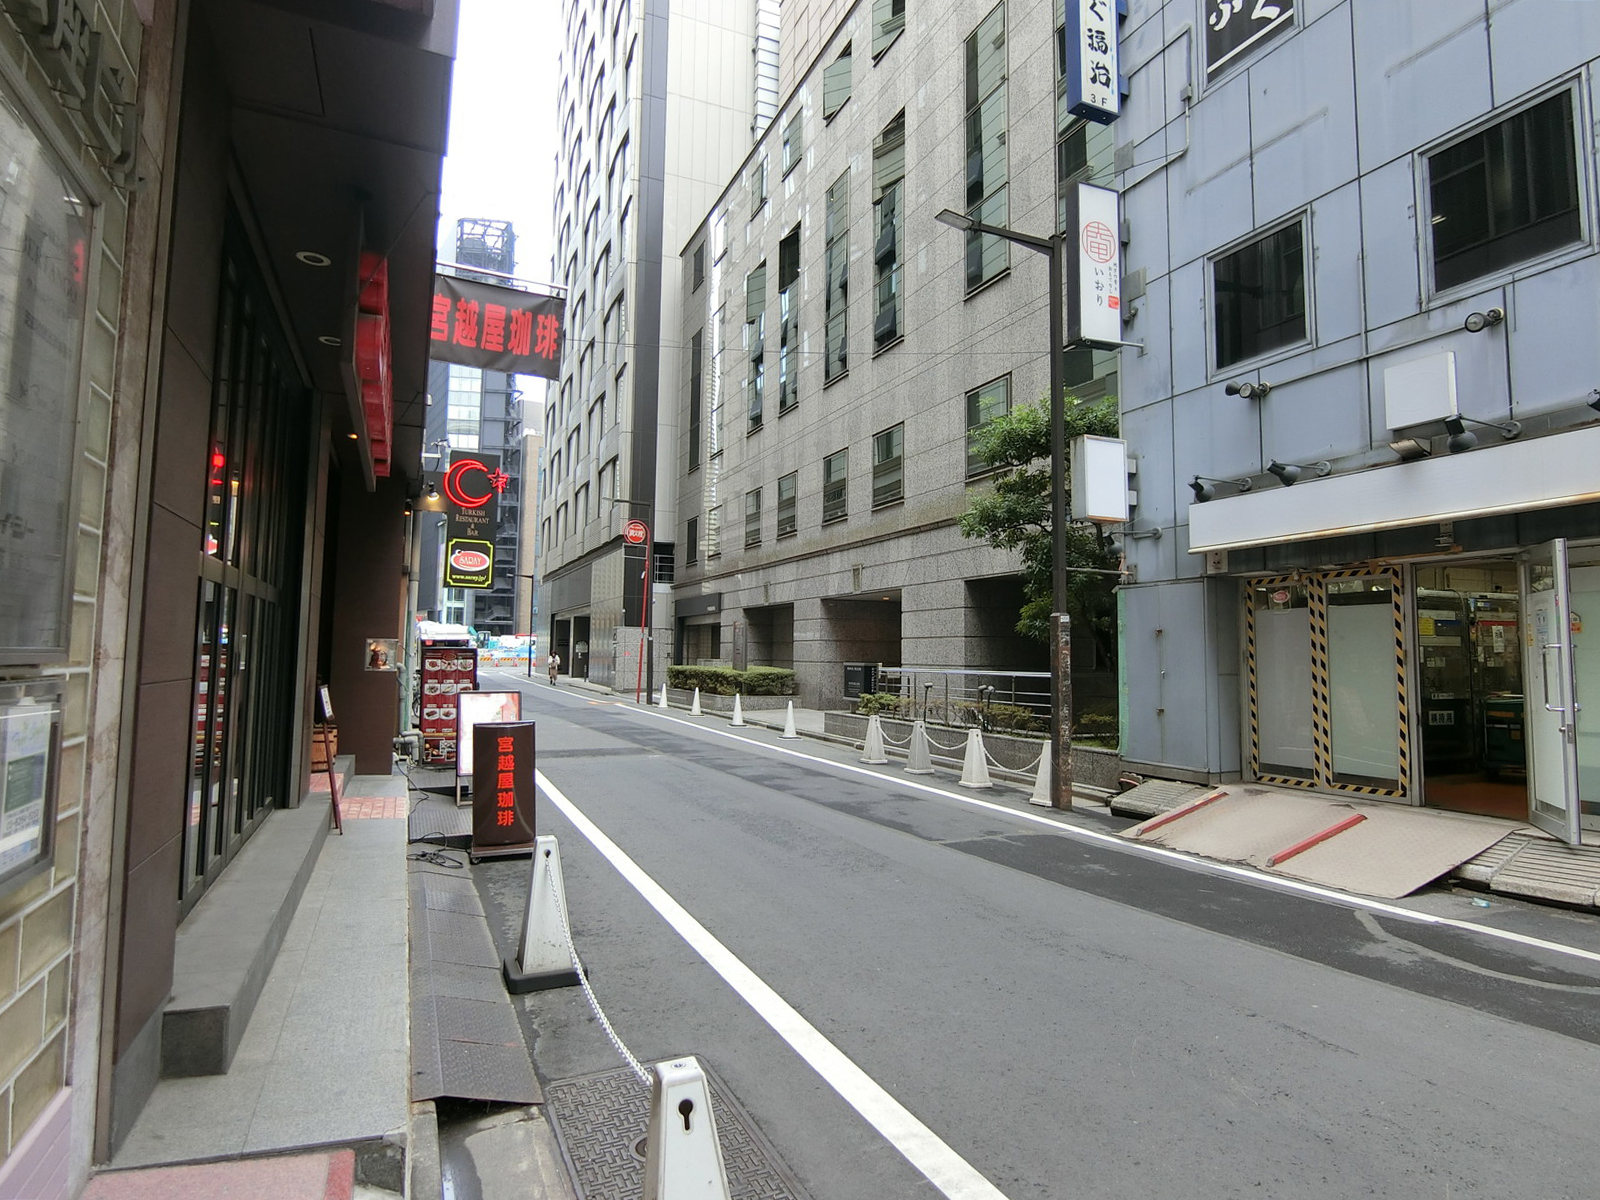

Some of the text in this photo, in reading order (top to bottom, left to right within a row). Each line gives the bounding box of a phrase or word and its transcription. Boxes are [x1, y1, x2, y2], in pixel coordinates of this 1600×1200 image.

[430, 293, 560, 360] 宮越屋珈琲
[459, 556, 482, 565] SARAY
[497, 736, 515, 826] 宮越屋珈琲
